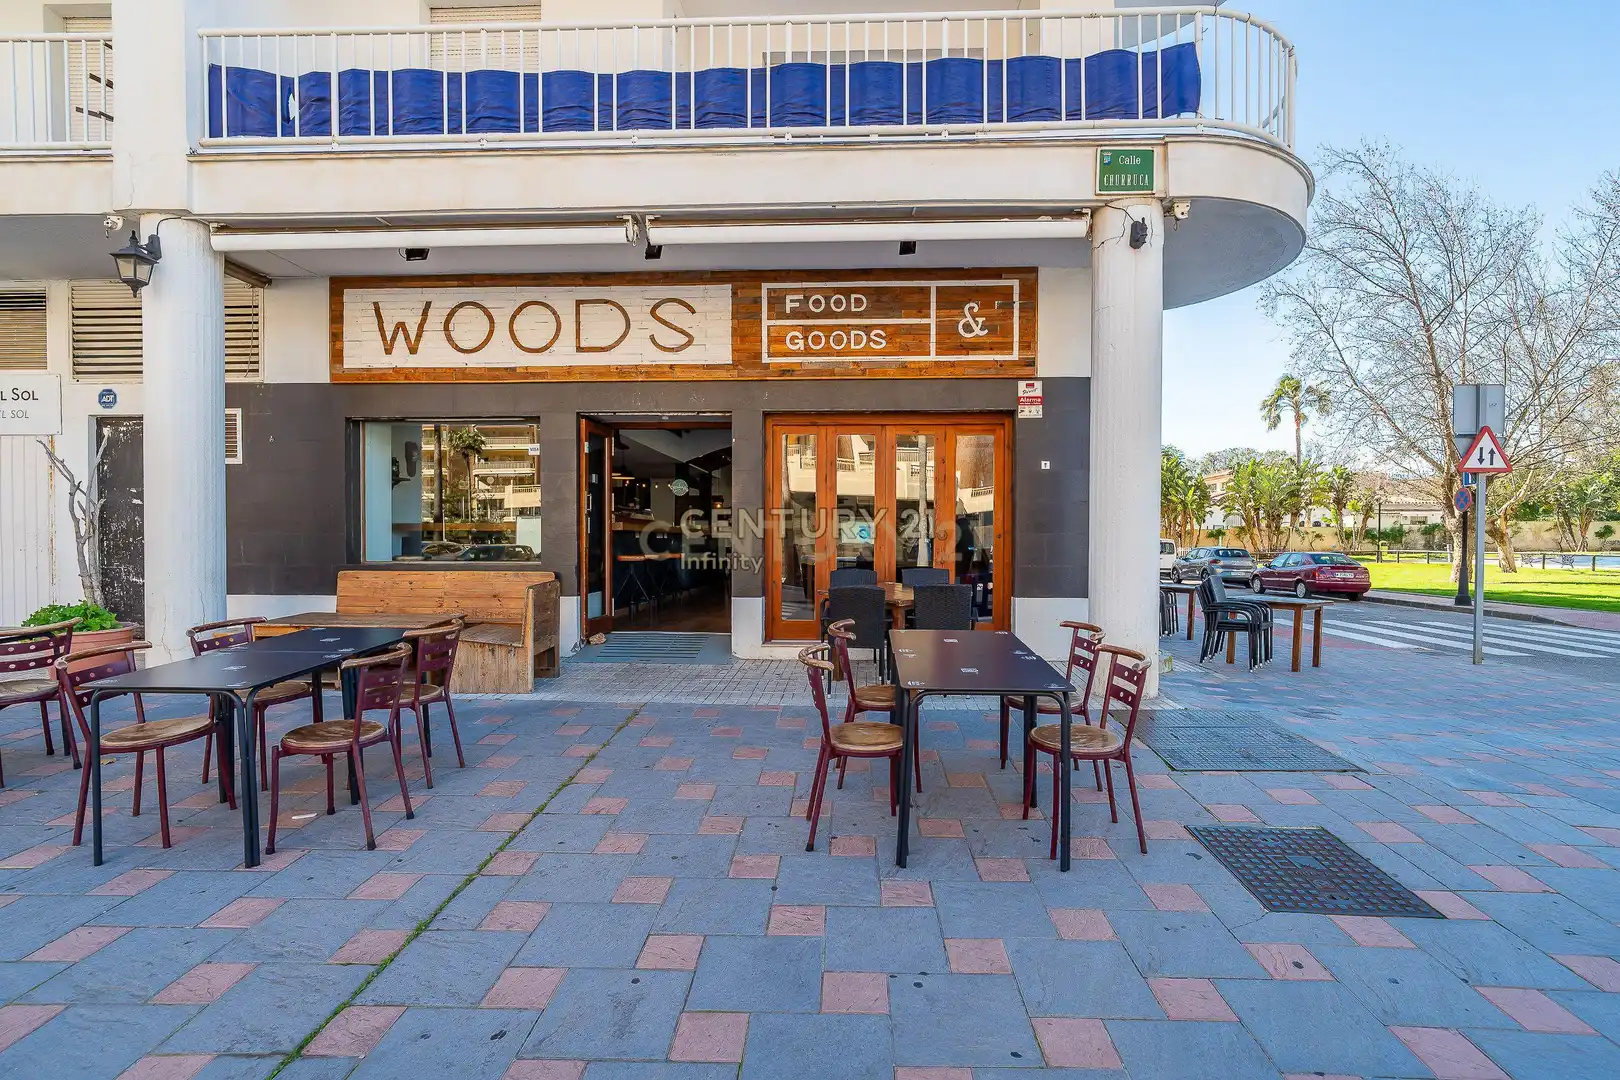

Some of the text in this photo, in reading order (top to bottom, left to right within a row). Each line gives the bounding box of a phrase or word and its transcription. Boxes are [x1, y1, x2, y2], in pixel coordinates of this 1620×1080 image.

[1118, 155, 1141, 165] Calle
[1103, 174, 1149, 186] CHURRUCA
[785, 294, 867, 313] FOOD
[958, 302, 989, 338] &
[373, 298, 696, 355] WOODS
[785, 329, 887, 350] GOODS
[101, 395, 114, 403] ADT
[1020, 396, 1041, 404] Alarma
[11, 409, 29, 419] SOL
